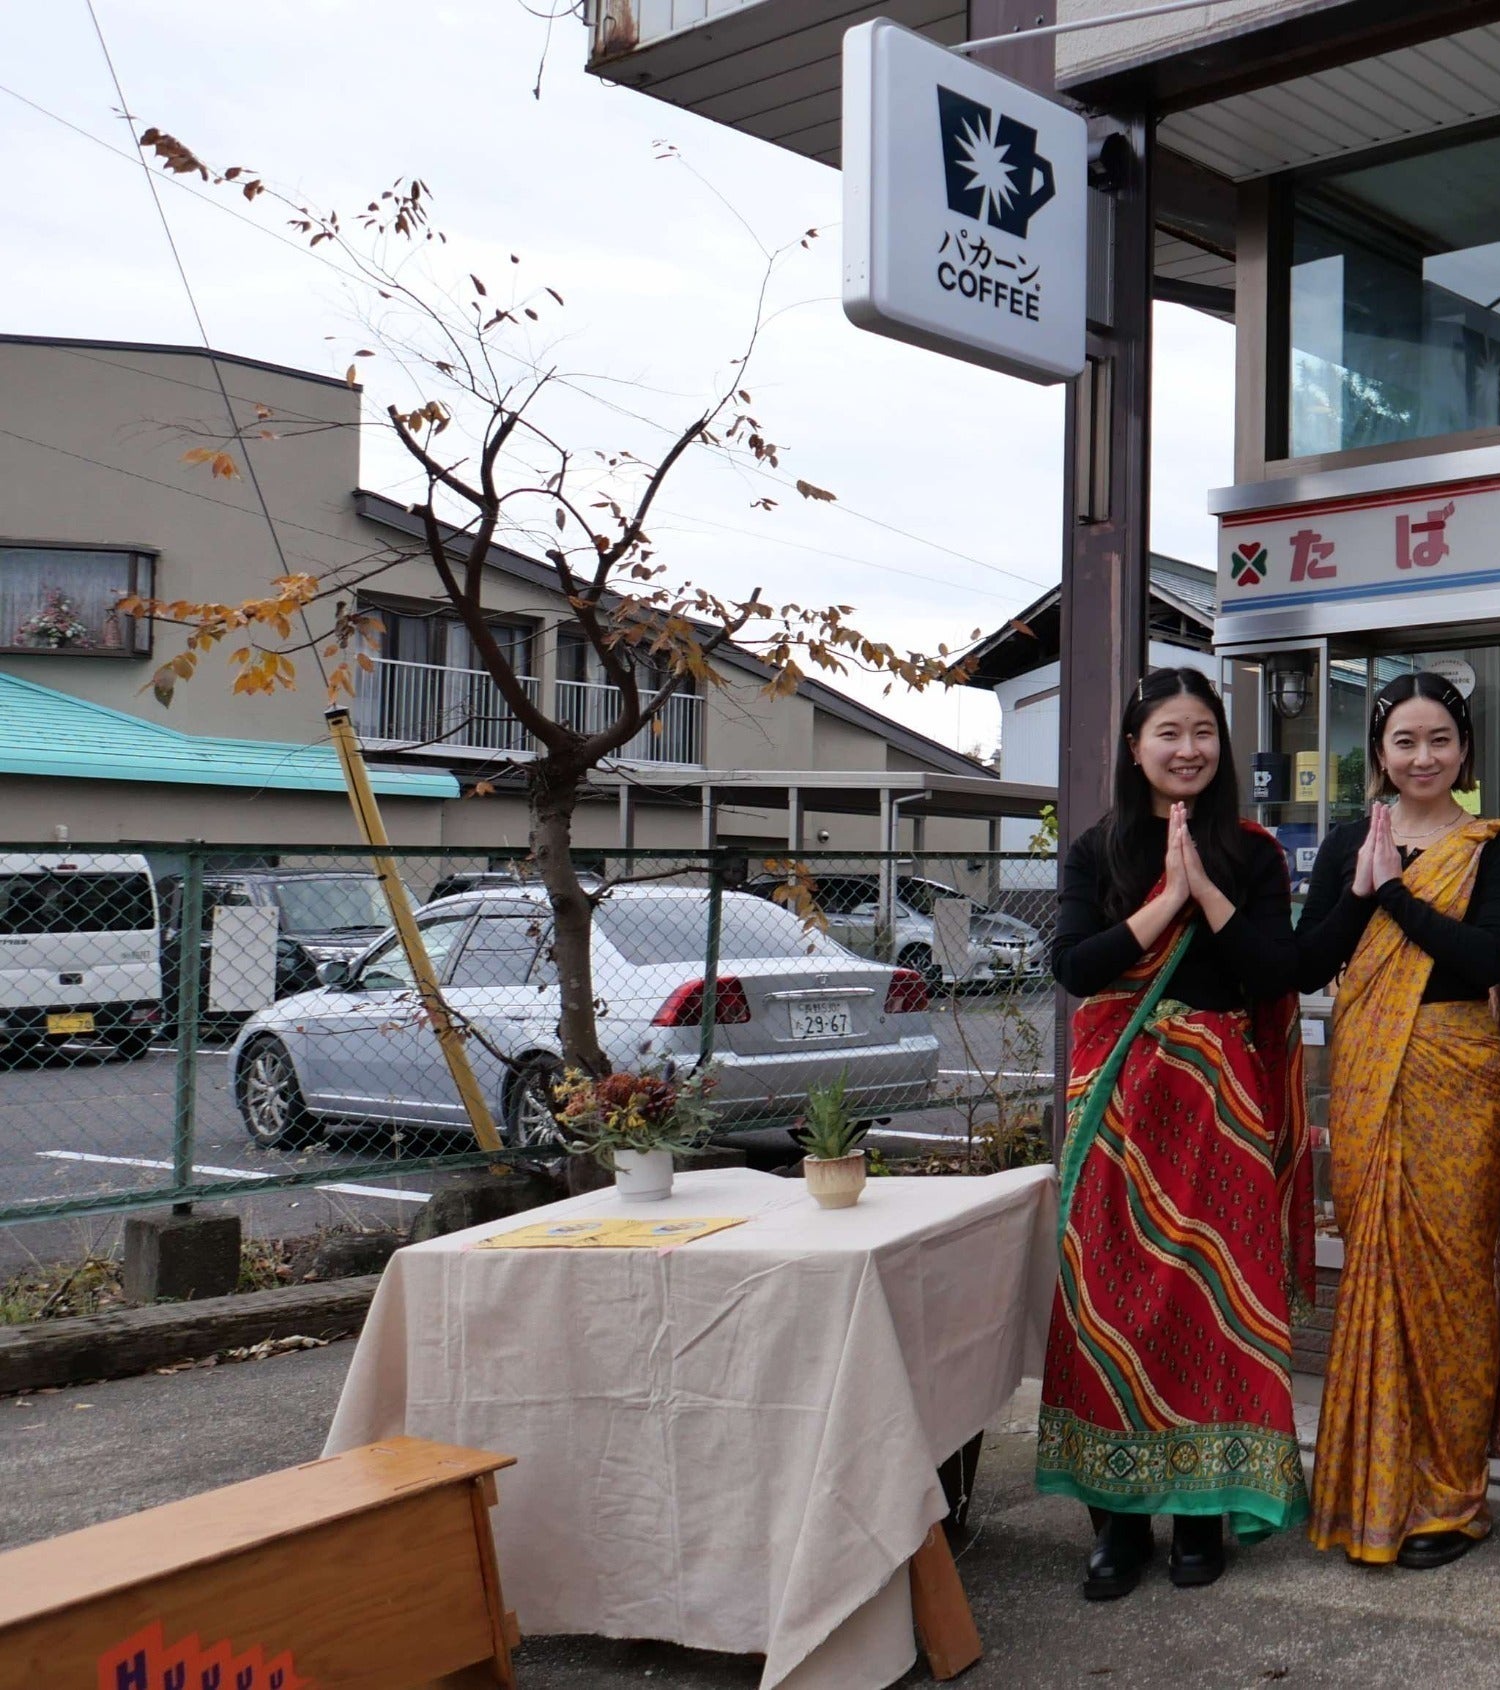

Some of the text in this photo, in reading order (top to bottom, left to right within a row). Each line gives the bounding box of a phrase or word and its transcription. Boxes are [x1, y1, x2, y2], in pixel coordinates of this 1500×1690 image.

[938, 229, 1041, 284] パカーン
[937, 262, 1040, 322] COFFEE
